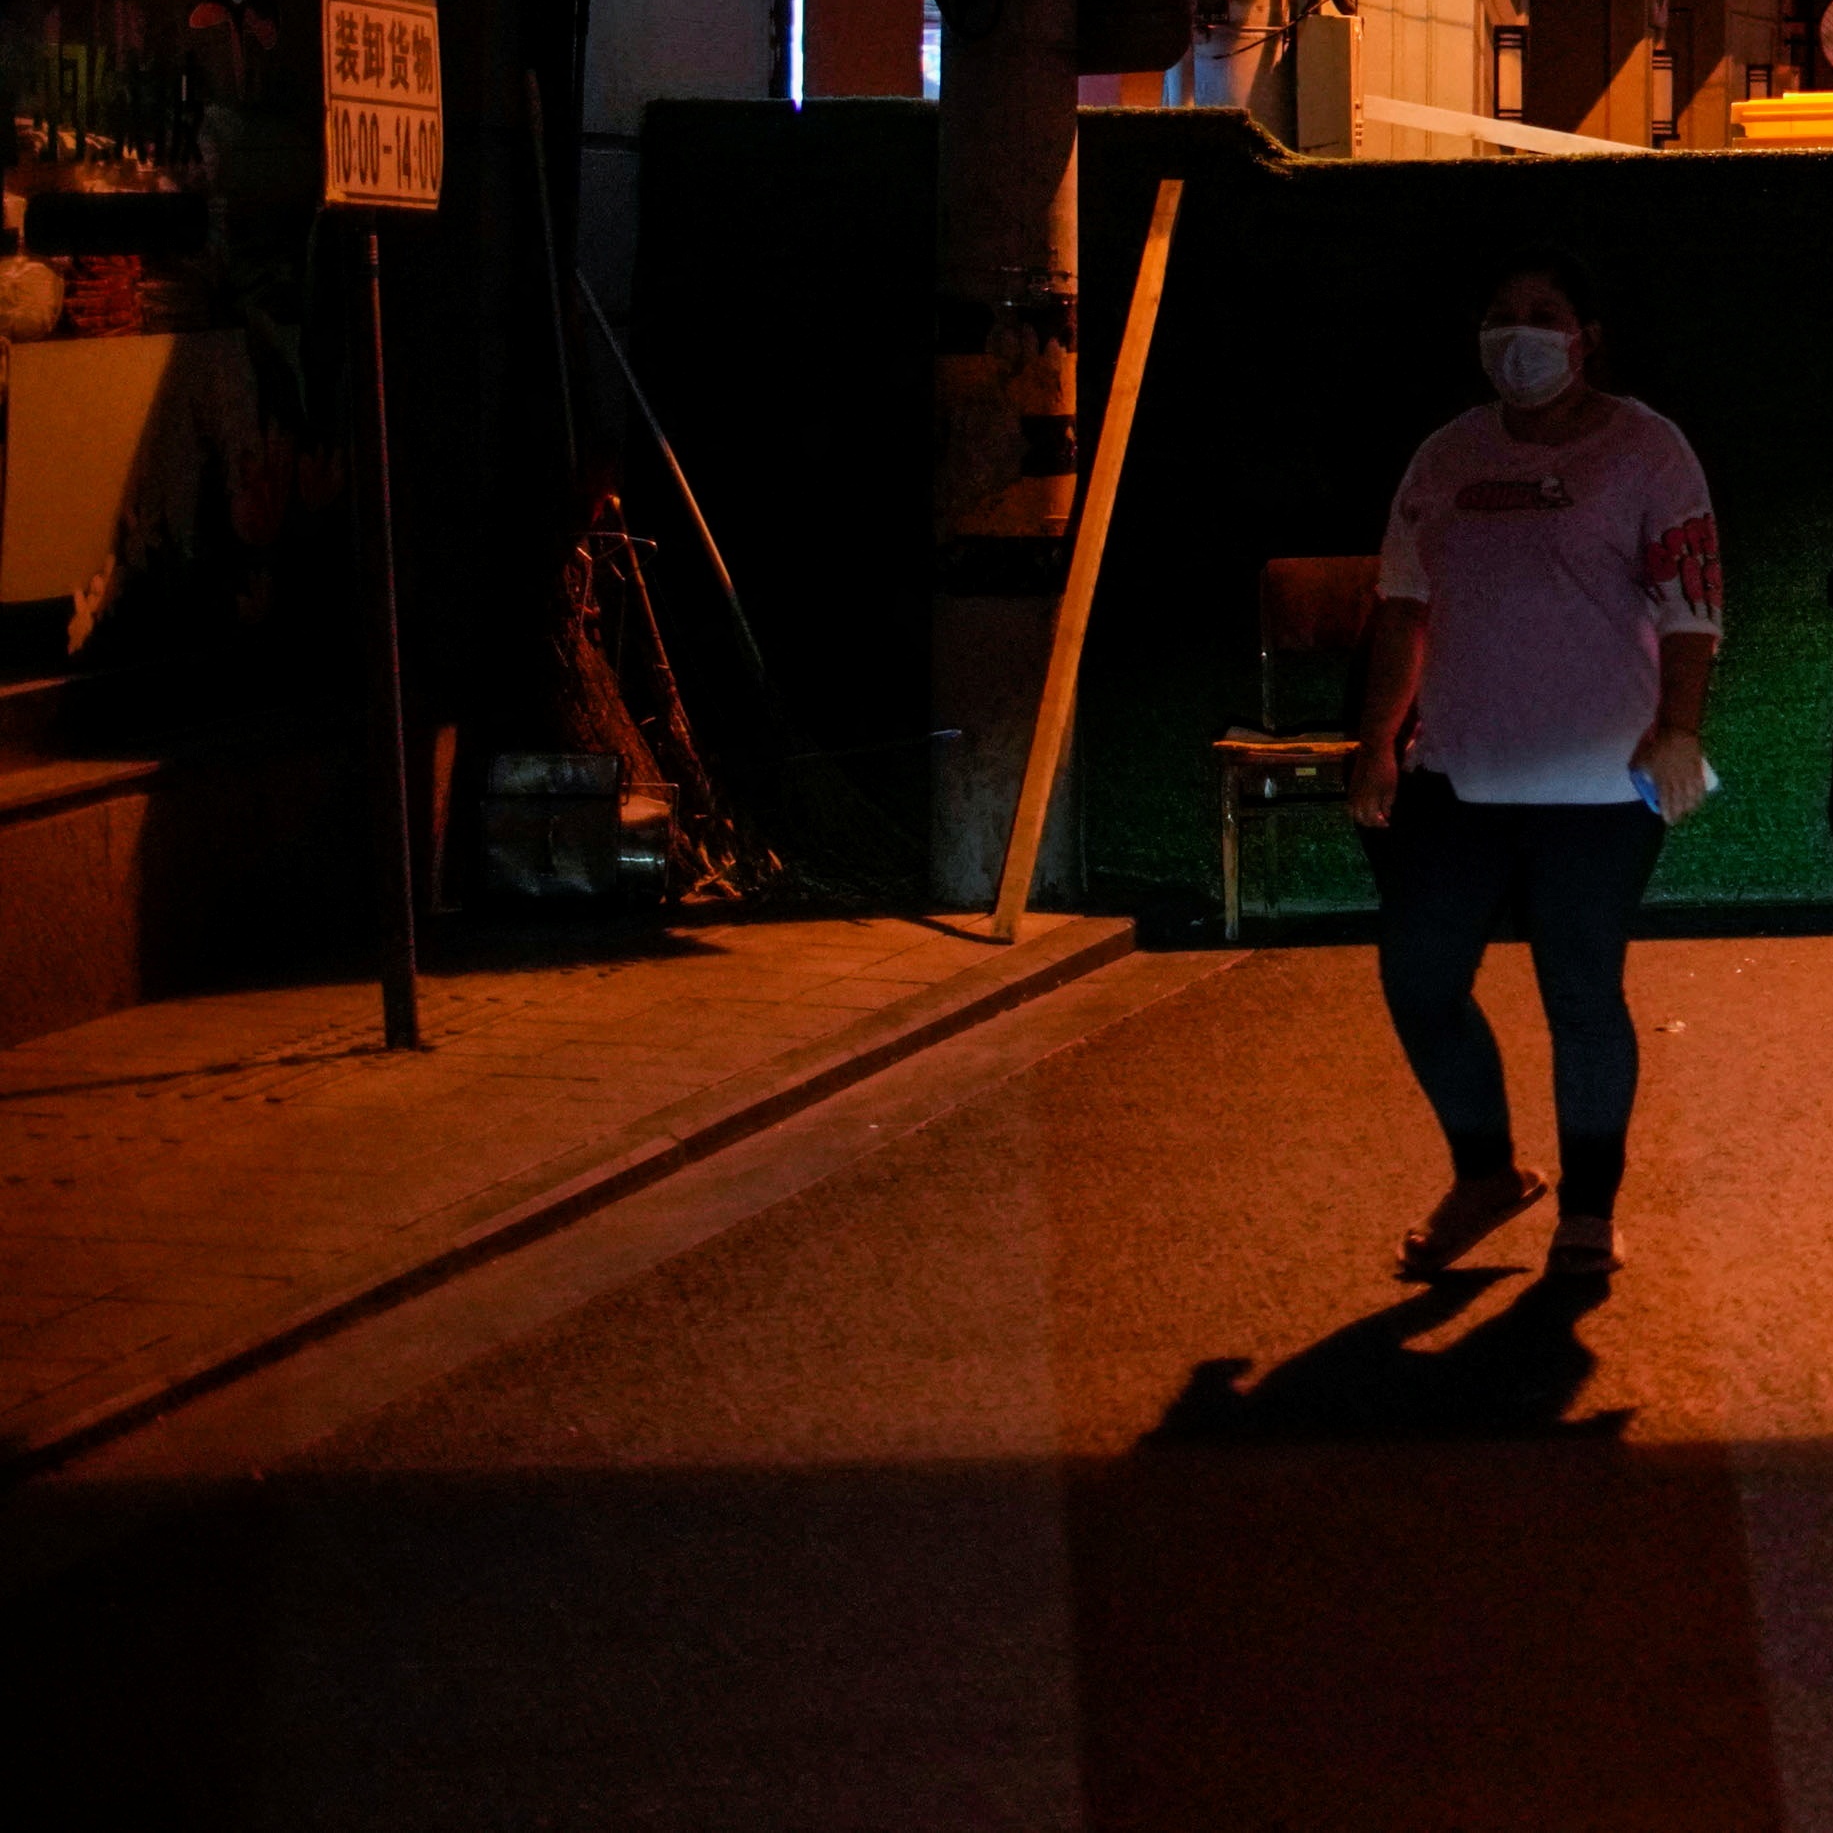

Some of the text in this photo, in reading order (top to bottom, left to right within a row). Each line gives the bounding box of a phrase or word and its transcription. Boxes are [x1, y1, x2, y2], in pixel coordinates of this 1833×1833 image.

[335, 10, 434, 95] 装卸货物
[334, 106, 438, 193] 10:00-14:00
